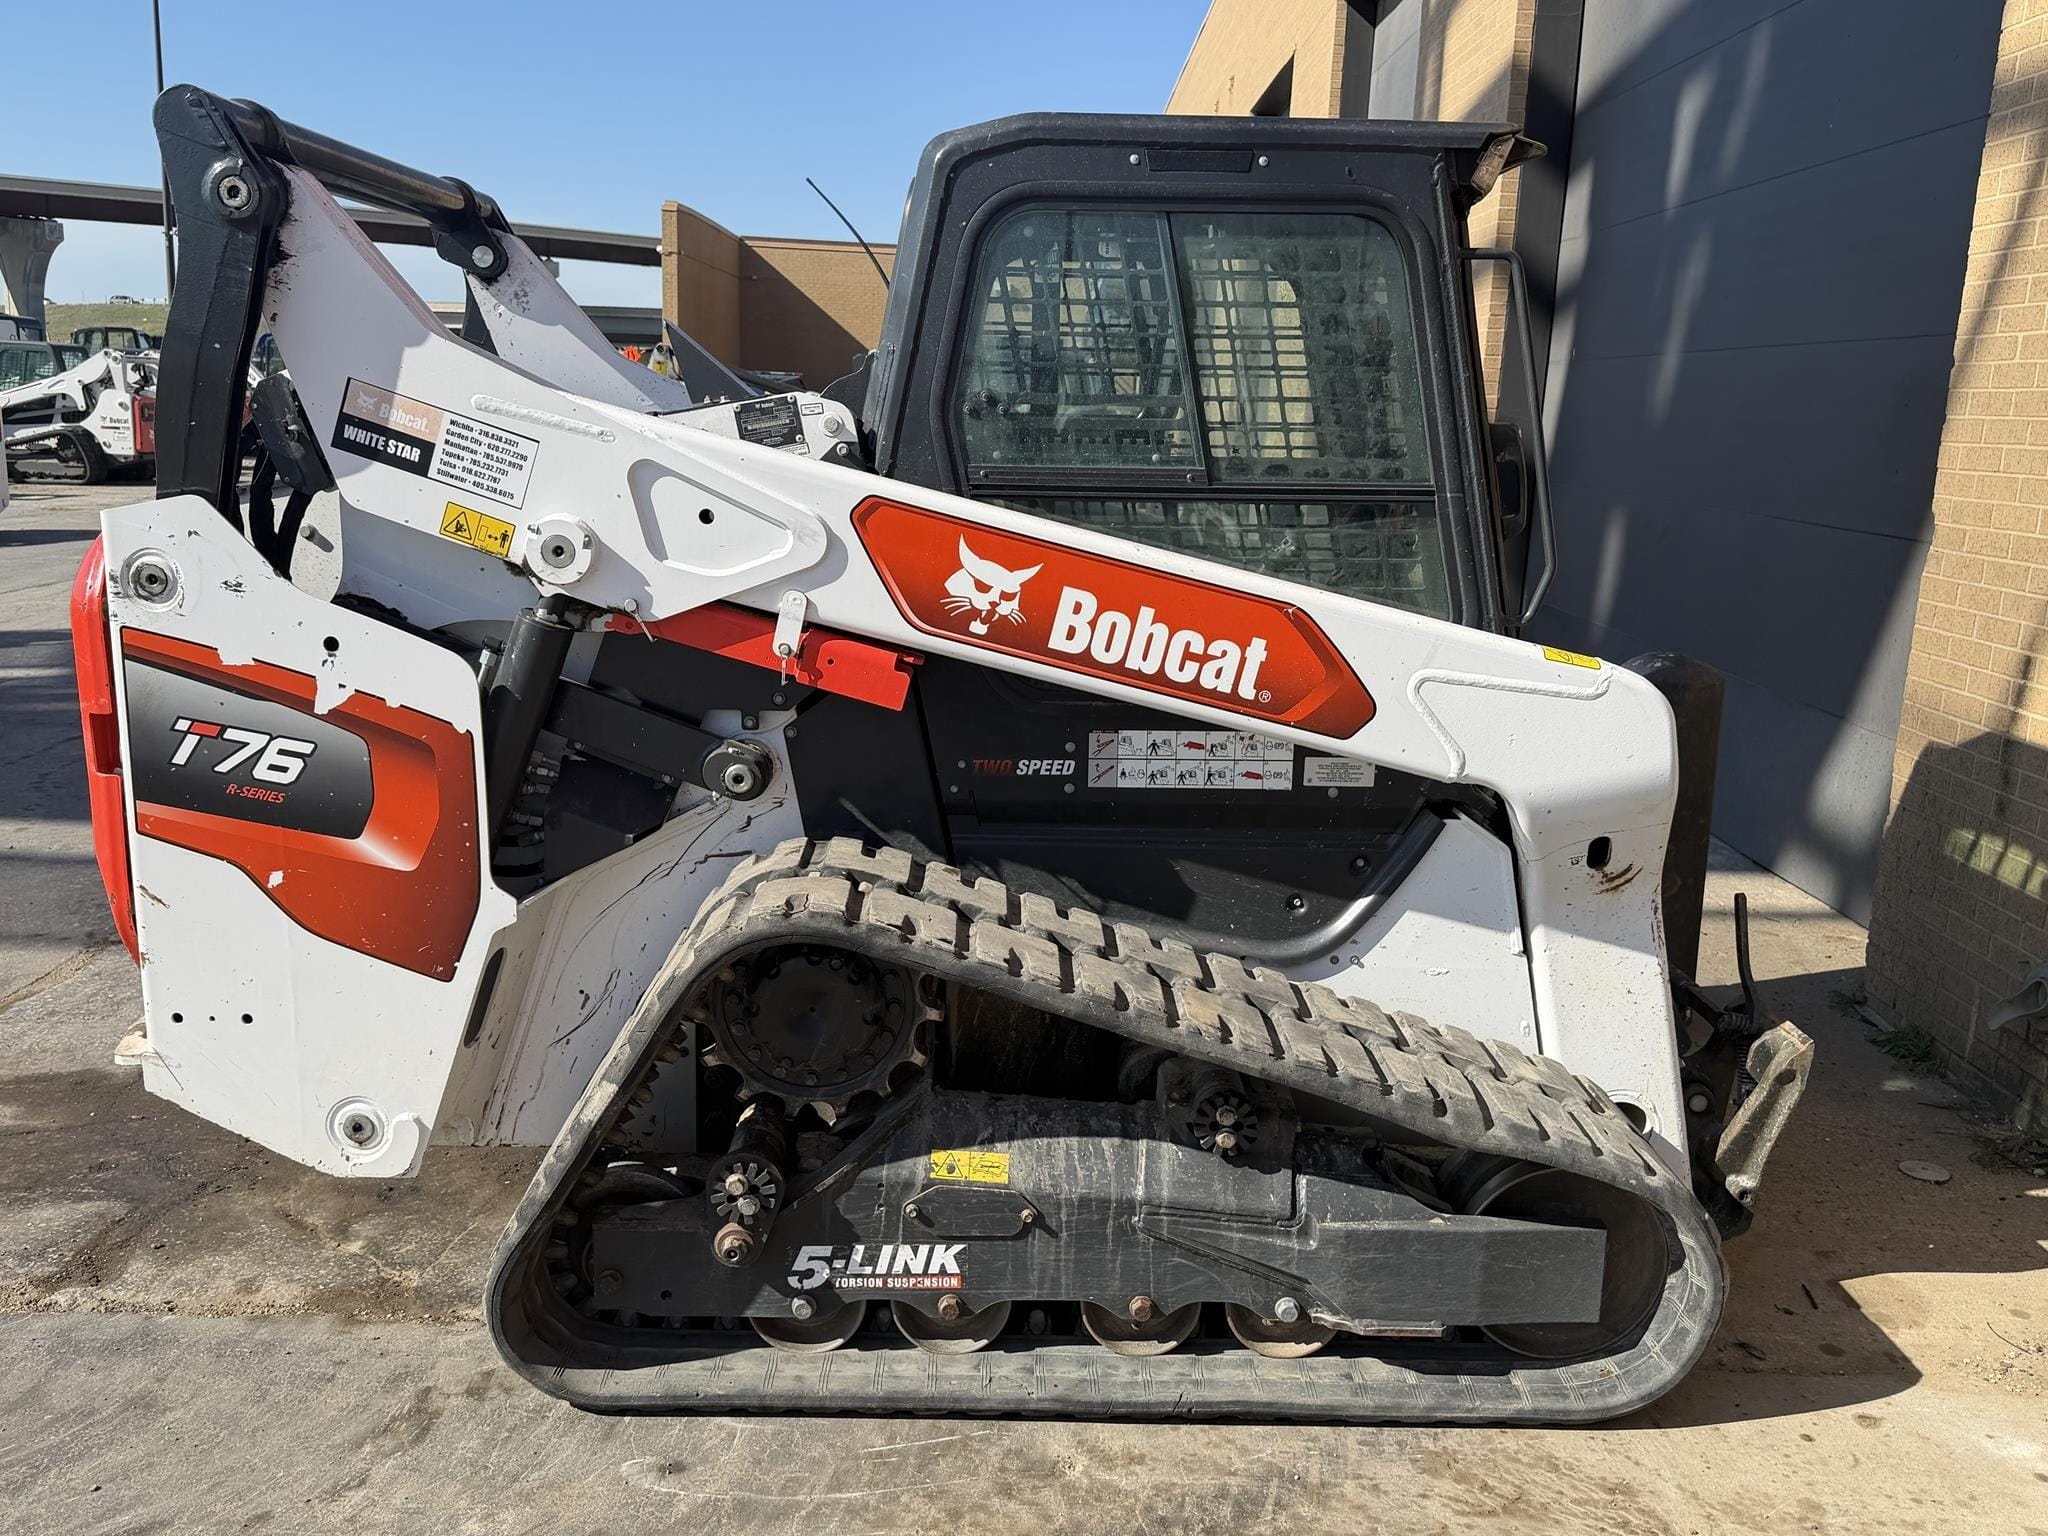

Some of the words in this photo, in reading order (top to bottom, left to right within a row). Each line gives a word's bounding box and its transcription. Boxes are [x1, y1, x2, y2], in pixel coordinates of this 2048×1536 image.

[378, 403, 428, 433] Bobcat
[449, 418, 474, 433] Wichita
[478, 428, 519, 448] 316.838.3321
[343, 424, 386, 450] WHITE
[387, 438, 422, 463] STAR
[444, 438, 478, 456] Manhattan
[446, 428, 469, 442] Garden
[469, 436, 483, 447] City
[487, 442, 529, 462] 620.277.2290
[439, 458, 457, 470] Tulsa
[461, 466, 501, 485] 918.622.7787
[441, 448, 465, 462] Topeka
[469, 457, 509, 477] 785.232.7731
[436, 468, 468, 484] Stillwater
[471, 480, 515, 500] 405.338.6075
[1047, 585, 1268, 701] Bobcat
[170, 717, 316, 785] T76
[973, 759, 1014, 776] TWO
[1015, 759, 1076, 776] SPEED
[225, 783, 286, 804] R-SERIES
[787, 1243, 967, 1290] 5-LINK
[835, 1277, 883, 1288] TORSION
[886, 1277, 958, 1288] SUSPENSION
